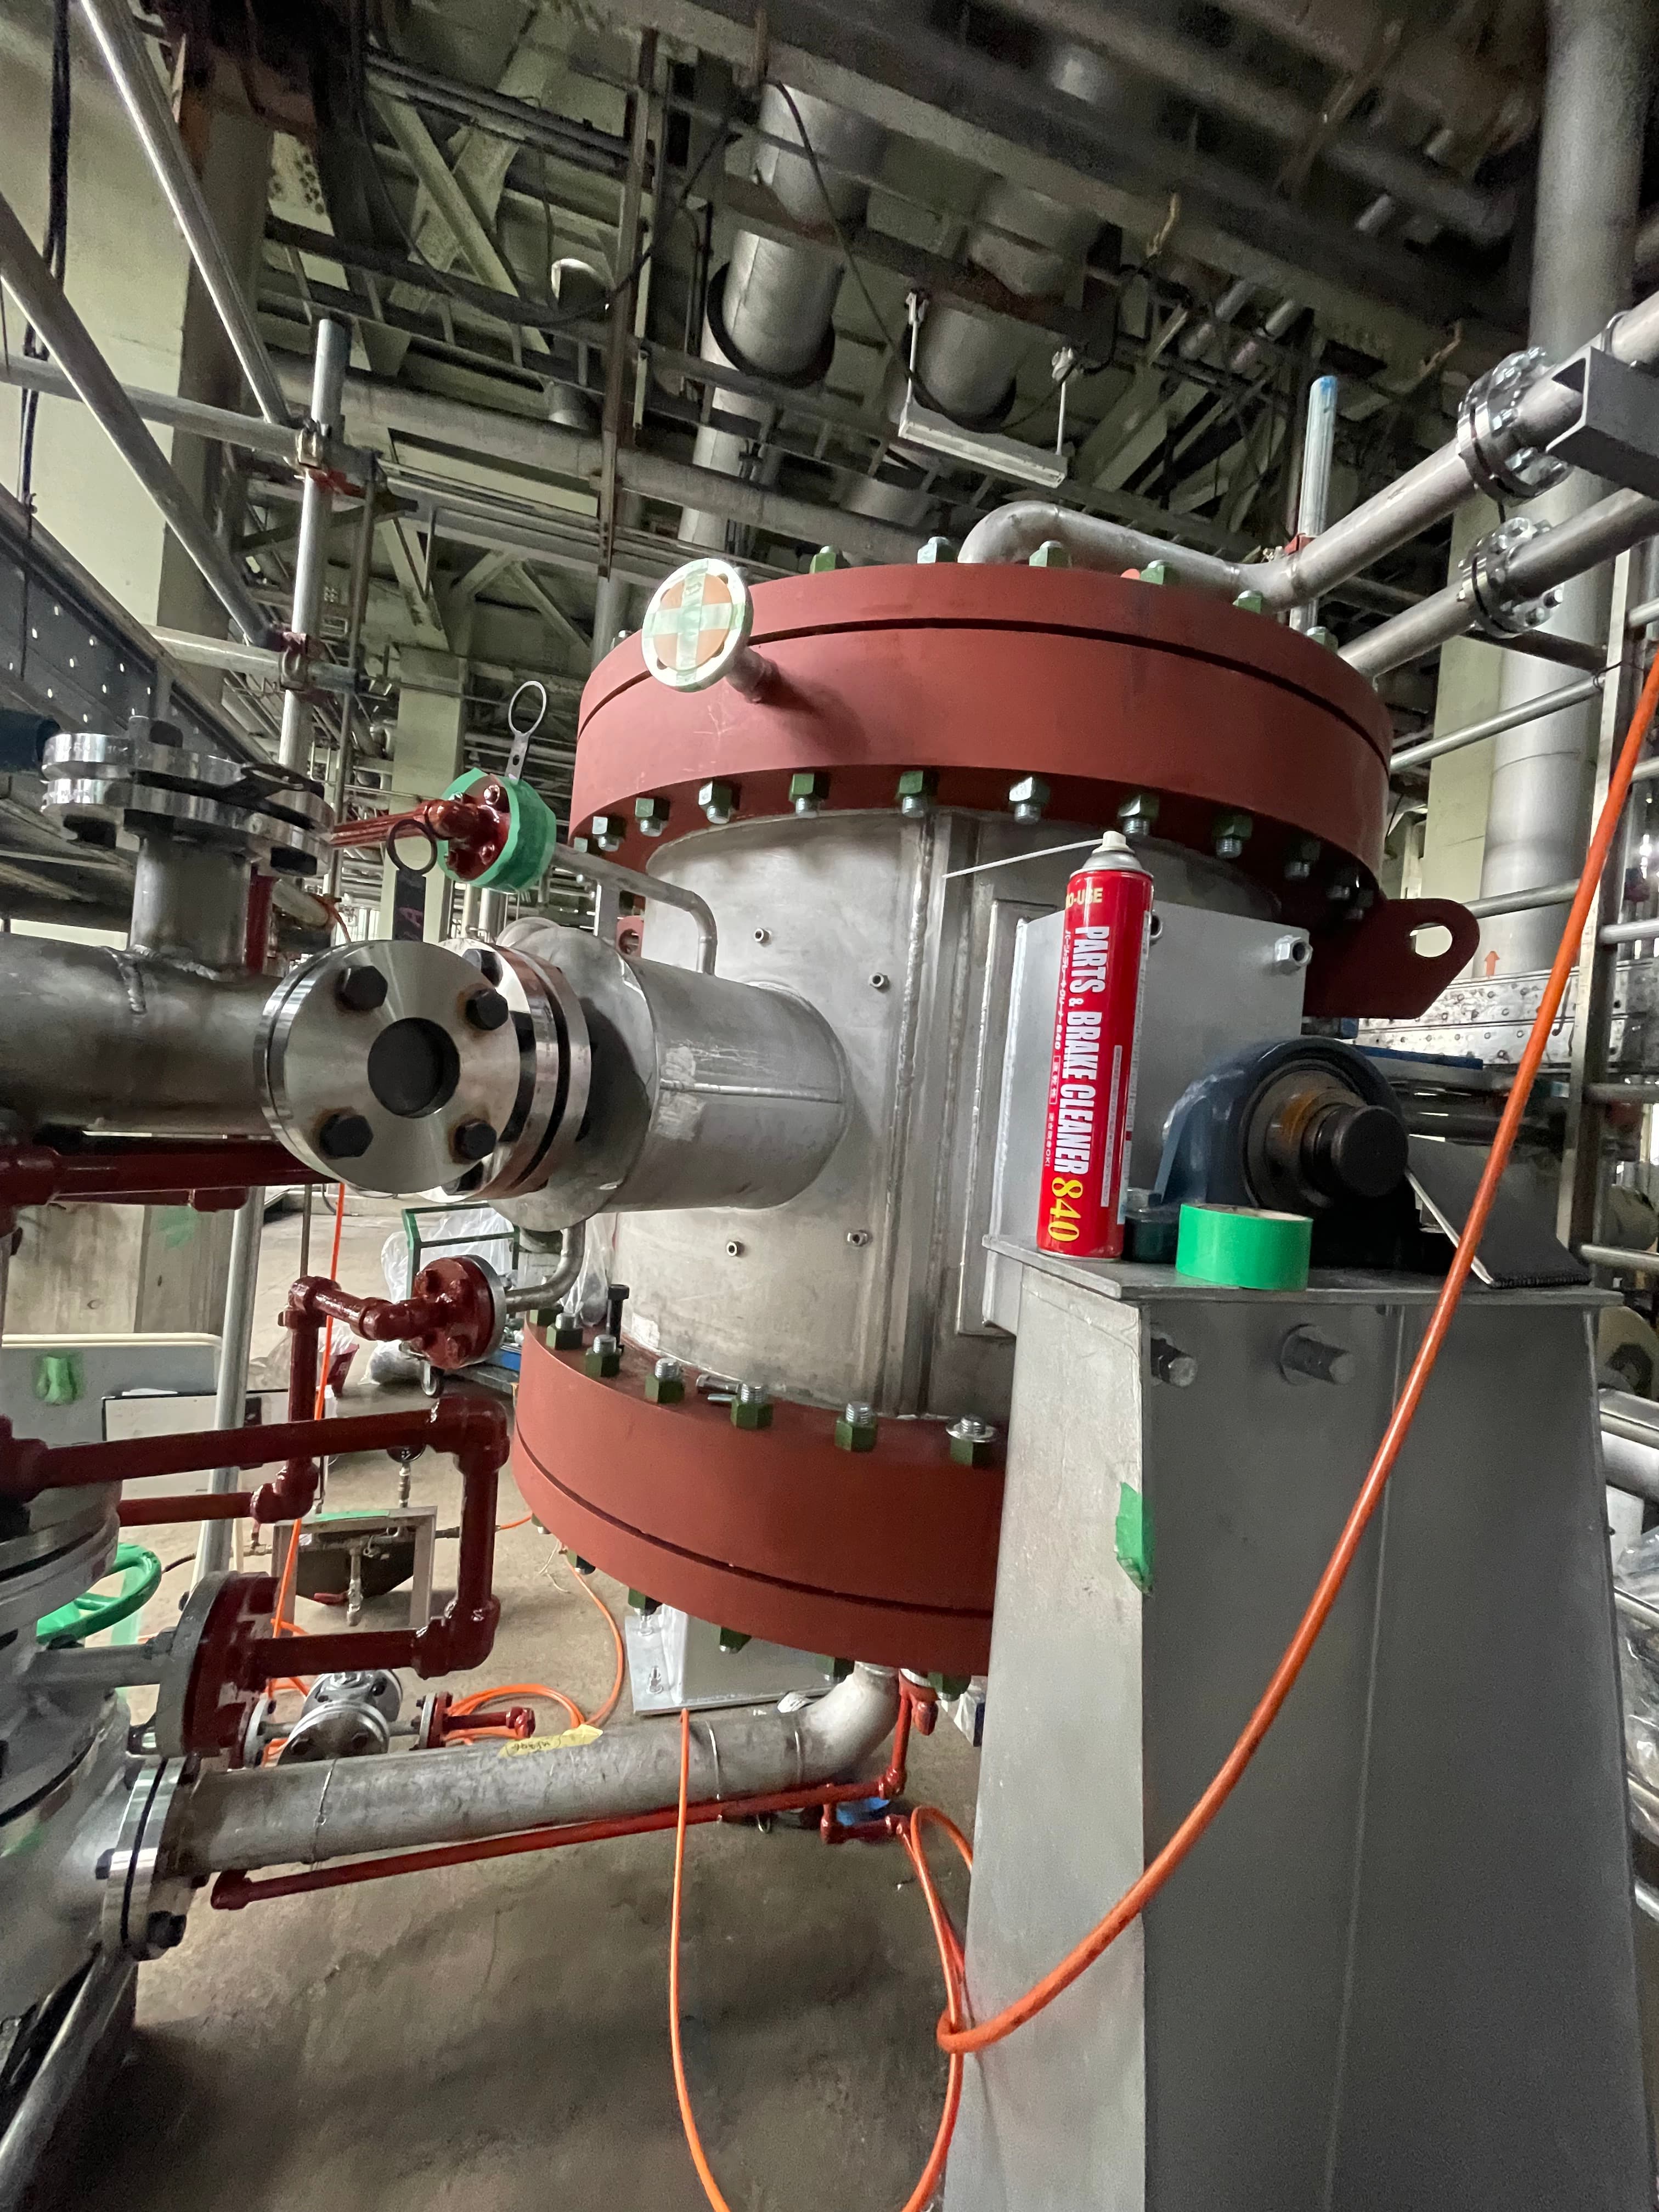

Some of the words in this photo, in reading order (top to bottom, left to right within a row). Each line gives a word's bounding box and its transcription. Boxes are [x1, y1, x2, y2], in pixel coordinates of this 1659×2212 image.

[1069, 926, 1109, 993] PARTS
[1069, 998, 1084, 1007] &
[1062, 1011, 1102, 1080] BRAKE
[1054, 1084, 1096, 1175] CLEANER
[1048, 1177, 1083, 1242] 840
